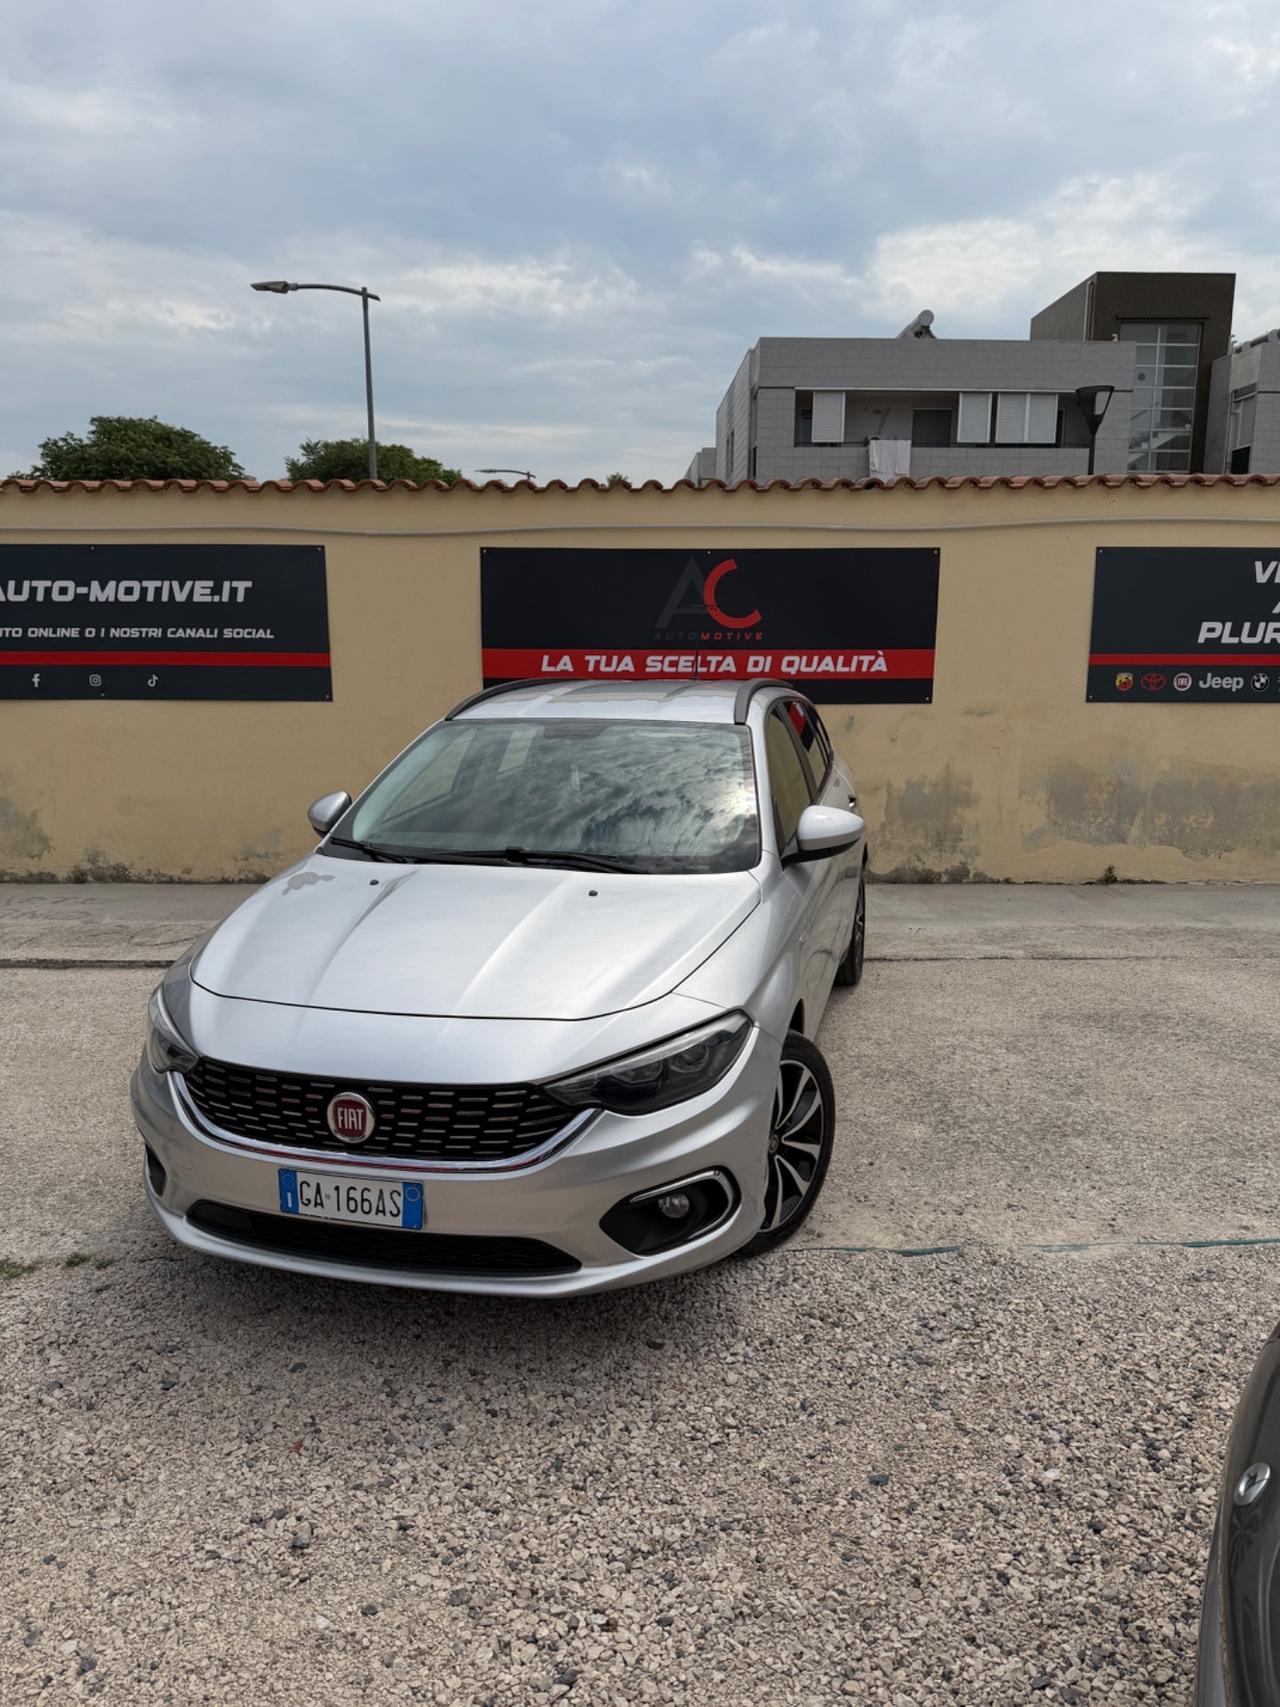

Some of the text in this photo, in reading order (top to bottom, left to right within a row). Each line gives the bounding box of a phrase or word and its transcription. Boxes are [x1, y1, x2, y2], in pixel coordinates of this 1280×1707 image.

[0, 627, 275, 639] TO ONLINE O I NOSTRI CANALI SOCIAL
[653, 632, 764, 641] AUTOMOTIVE
[541, 650, 888, 675] LA TUA SCELTA DI QUALITÀ
[1198, 672, 1244, 692] Jeep
[337, 1107, 365, 1131] FIAT
